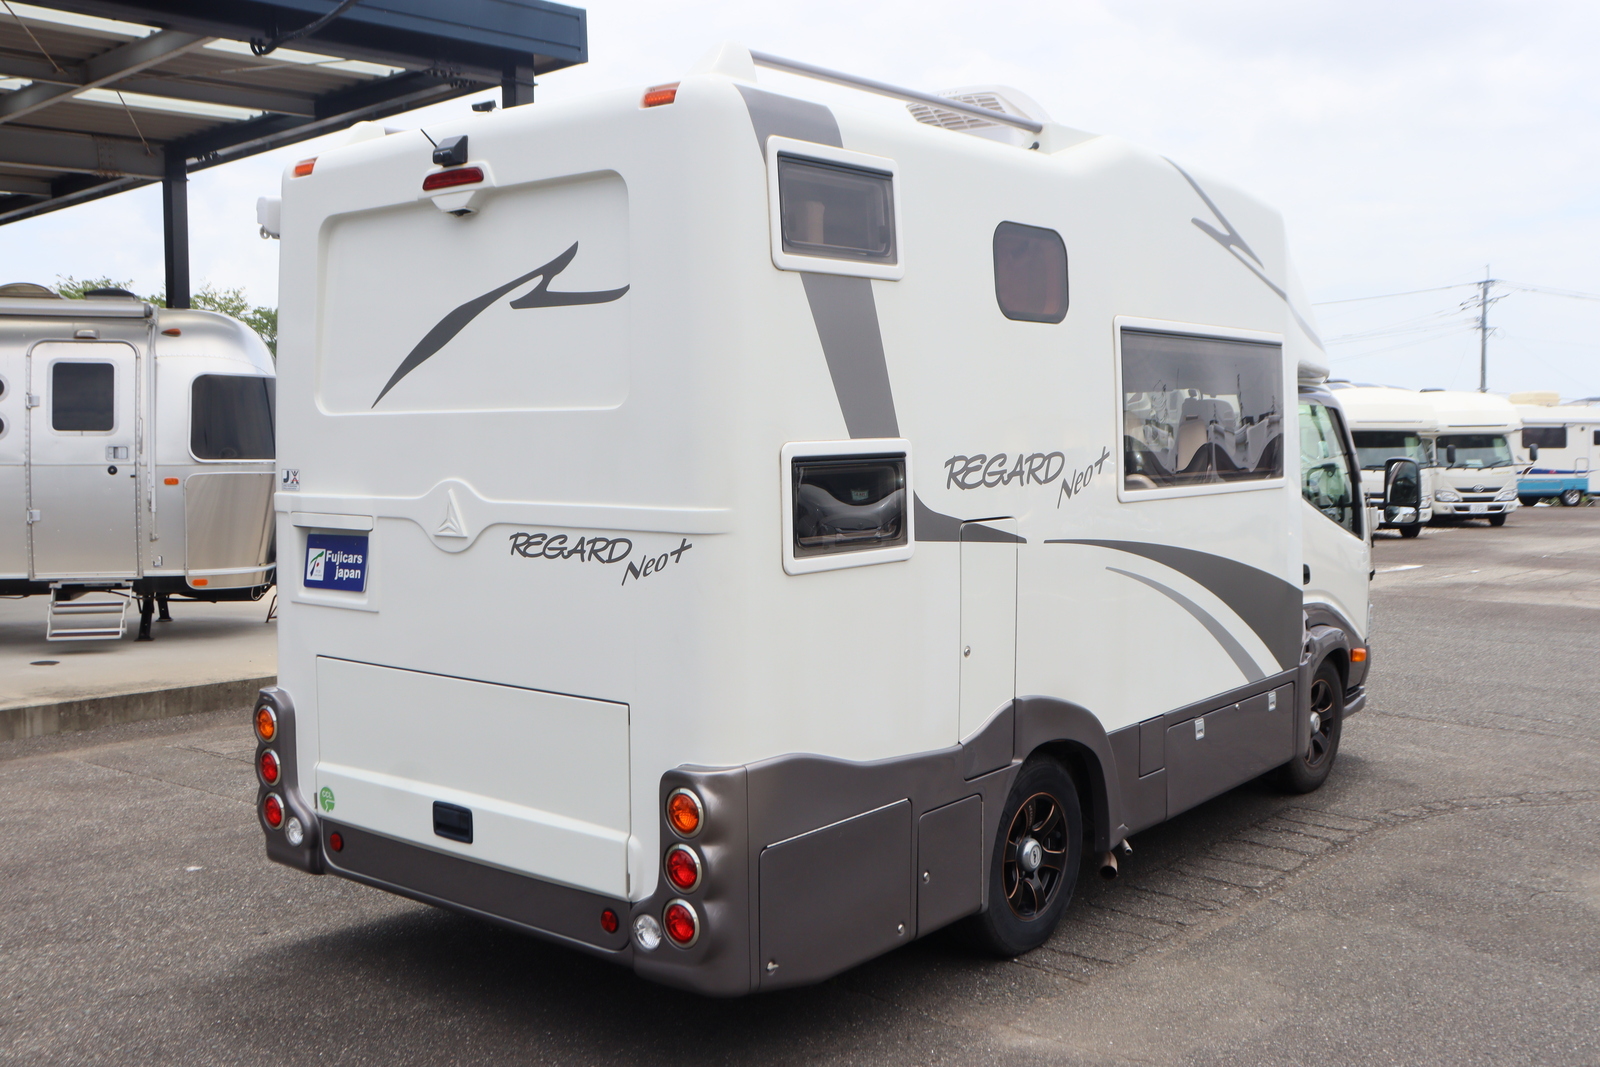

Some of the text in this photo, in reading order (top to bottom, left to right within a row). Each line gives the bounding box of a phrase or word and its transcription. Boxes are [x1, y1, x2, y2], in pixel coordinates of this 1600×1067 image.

[944, 446, 1110, 509] REGARD Neo+
[325, 550, 363, 566] Fujicars
[334, 565, 361, 581] japan
[509, 532, 692, 586] REGARD Neo+
